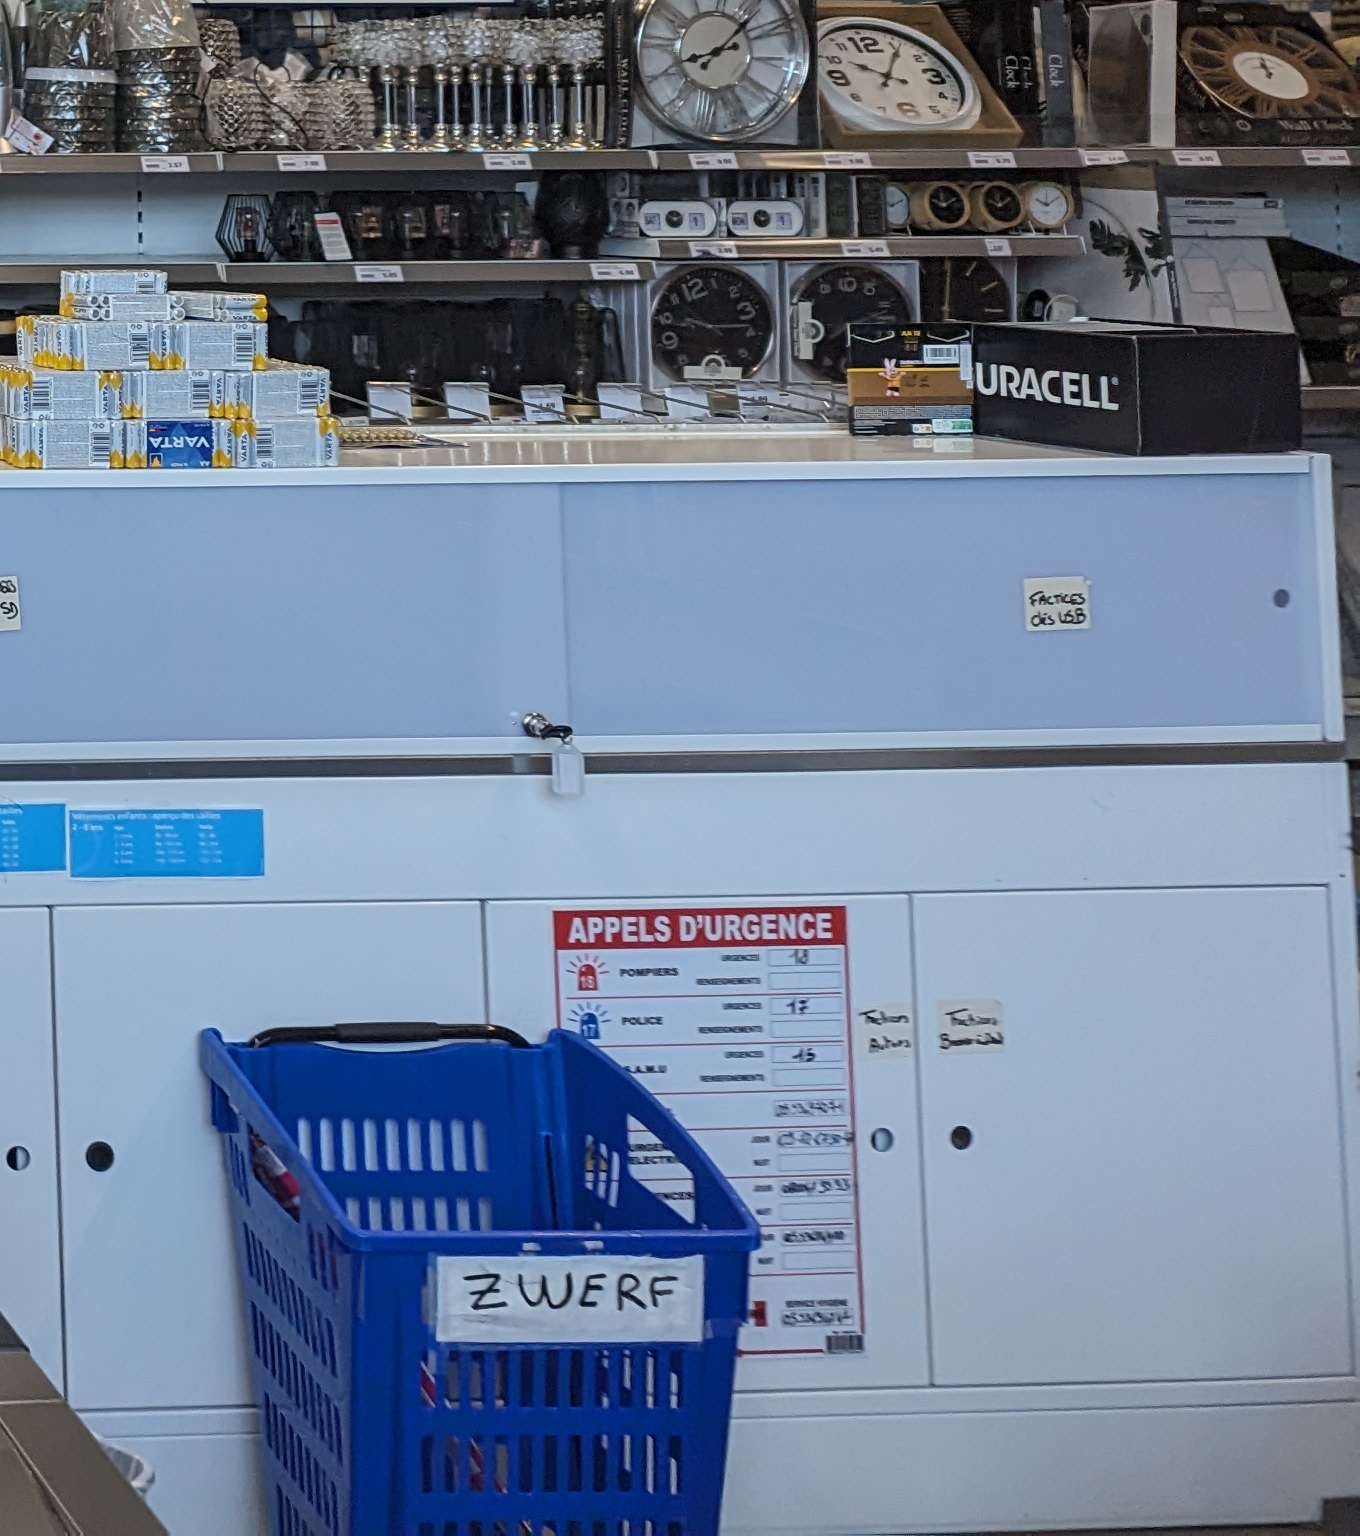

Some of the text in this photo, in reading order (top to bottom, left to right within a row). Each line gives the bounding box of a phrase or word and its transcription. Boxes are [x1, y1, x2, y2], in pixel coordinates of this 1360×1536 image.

[847, 36, 884, 54] 12
[826, 69, 851, 87] 9
[921, 68, 946, 85] 3
[1005, 55, 1021, 90] Clock
[1048, 54, 1066, 88] Clock
[681, 278, 709, 302] 12
[736, 302, 757, 320] 3
[975, 362, 1120, 411] URACELL
[148, 436, 210, 449] VARTA
[0, 602, 18, 619] SD
[1058, 608, 1086, 624] USB
[568, 913, 834, 944] APPELS D'URGENCE
[620, 967, 679, 978] POMPIERS
[621, 1016, 664, 1026] POLICE
[582, 1024, 594, 1037] 17
[463, 1272, 679, 1311] ZWERF
